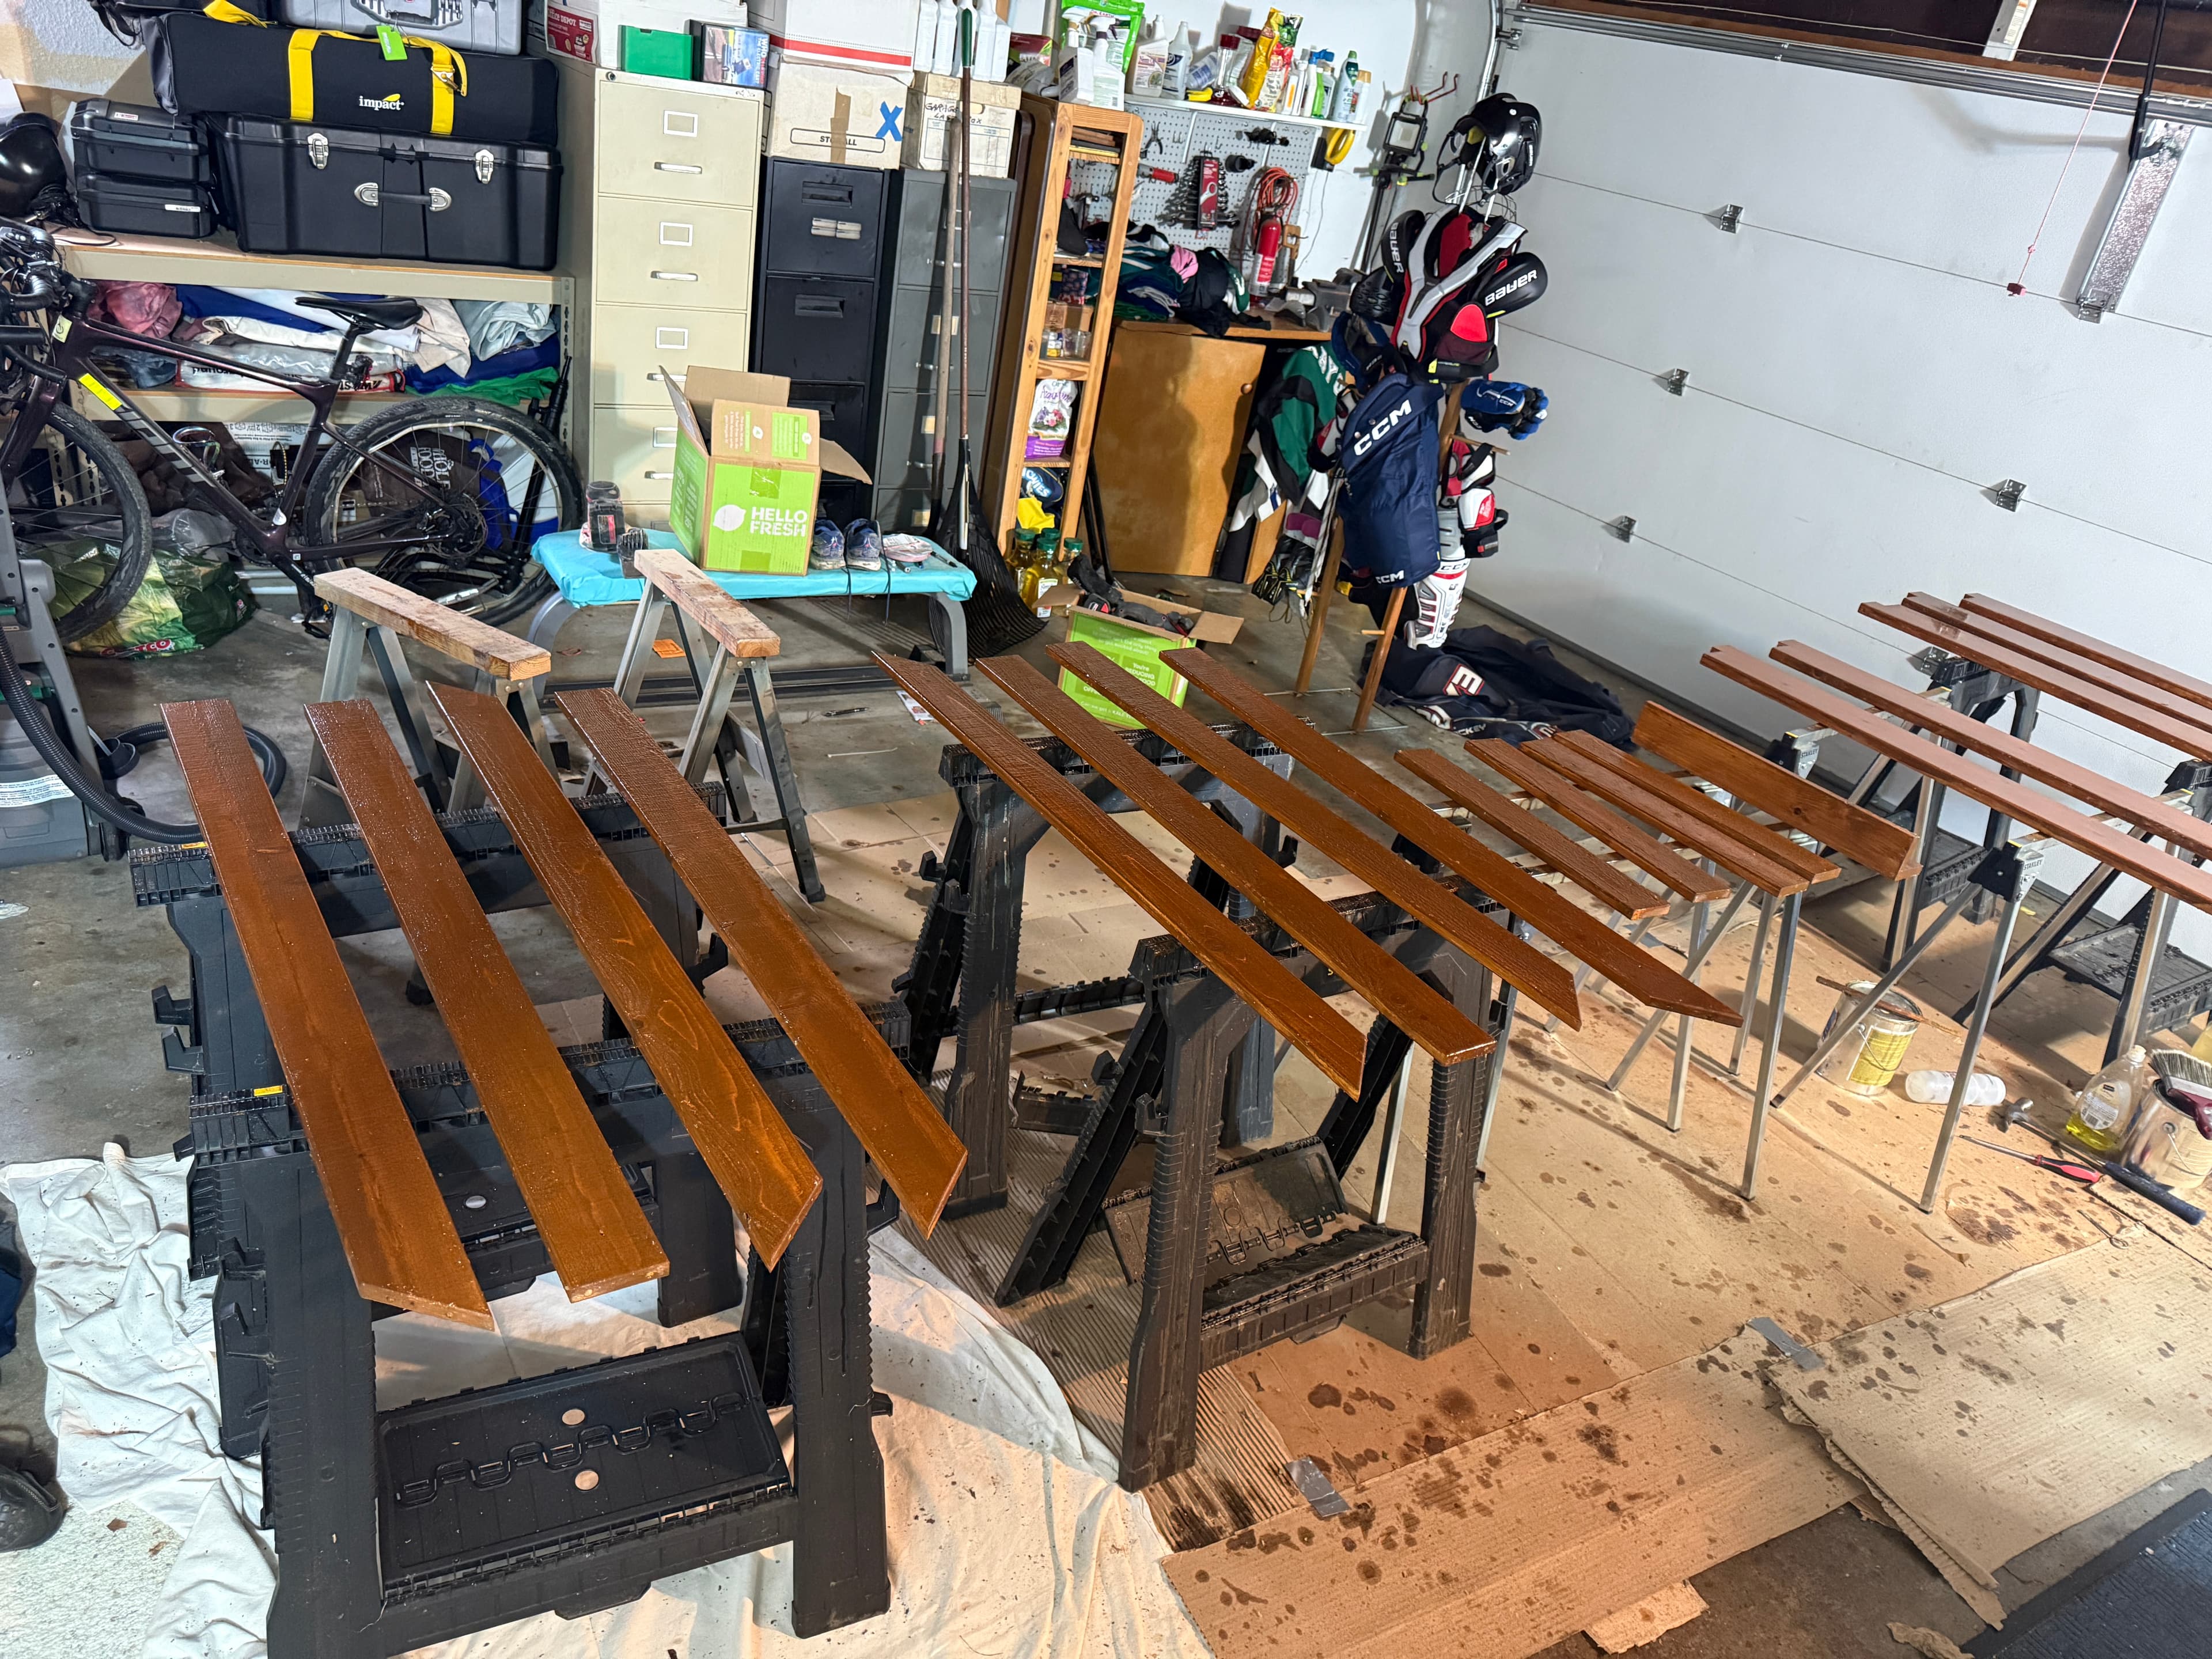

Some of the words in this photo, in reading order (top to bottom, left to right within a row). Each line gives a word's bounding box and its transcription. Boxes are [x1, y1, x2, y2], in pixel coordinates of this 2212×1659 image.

[760, 37, 769, 58] WHO
[358, 95, 402, 111] impact
[1484, 269, 1537, 306] BAUER
[1354, 399, 1412, 456] CCM
[418, 448, 435, 480] FOOD
[751, 506, 807, 523] HELLO
[750, 520, 806, 537] FRESH
[100, 638, 172, 658] CTCO
[1456, 723, 1487, 736] CKEY
[2023, 859, 2043, 870] STANLEY
